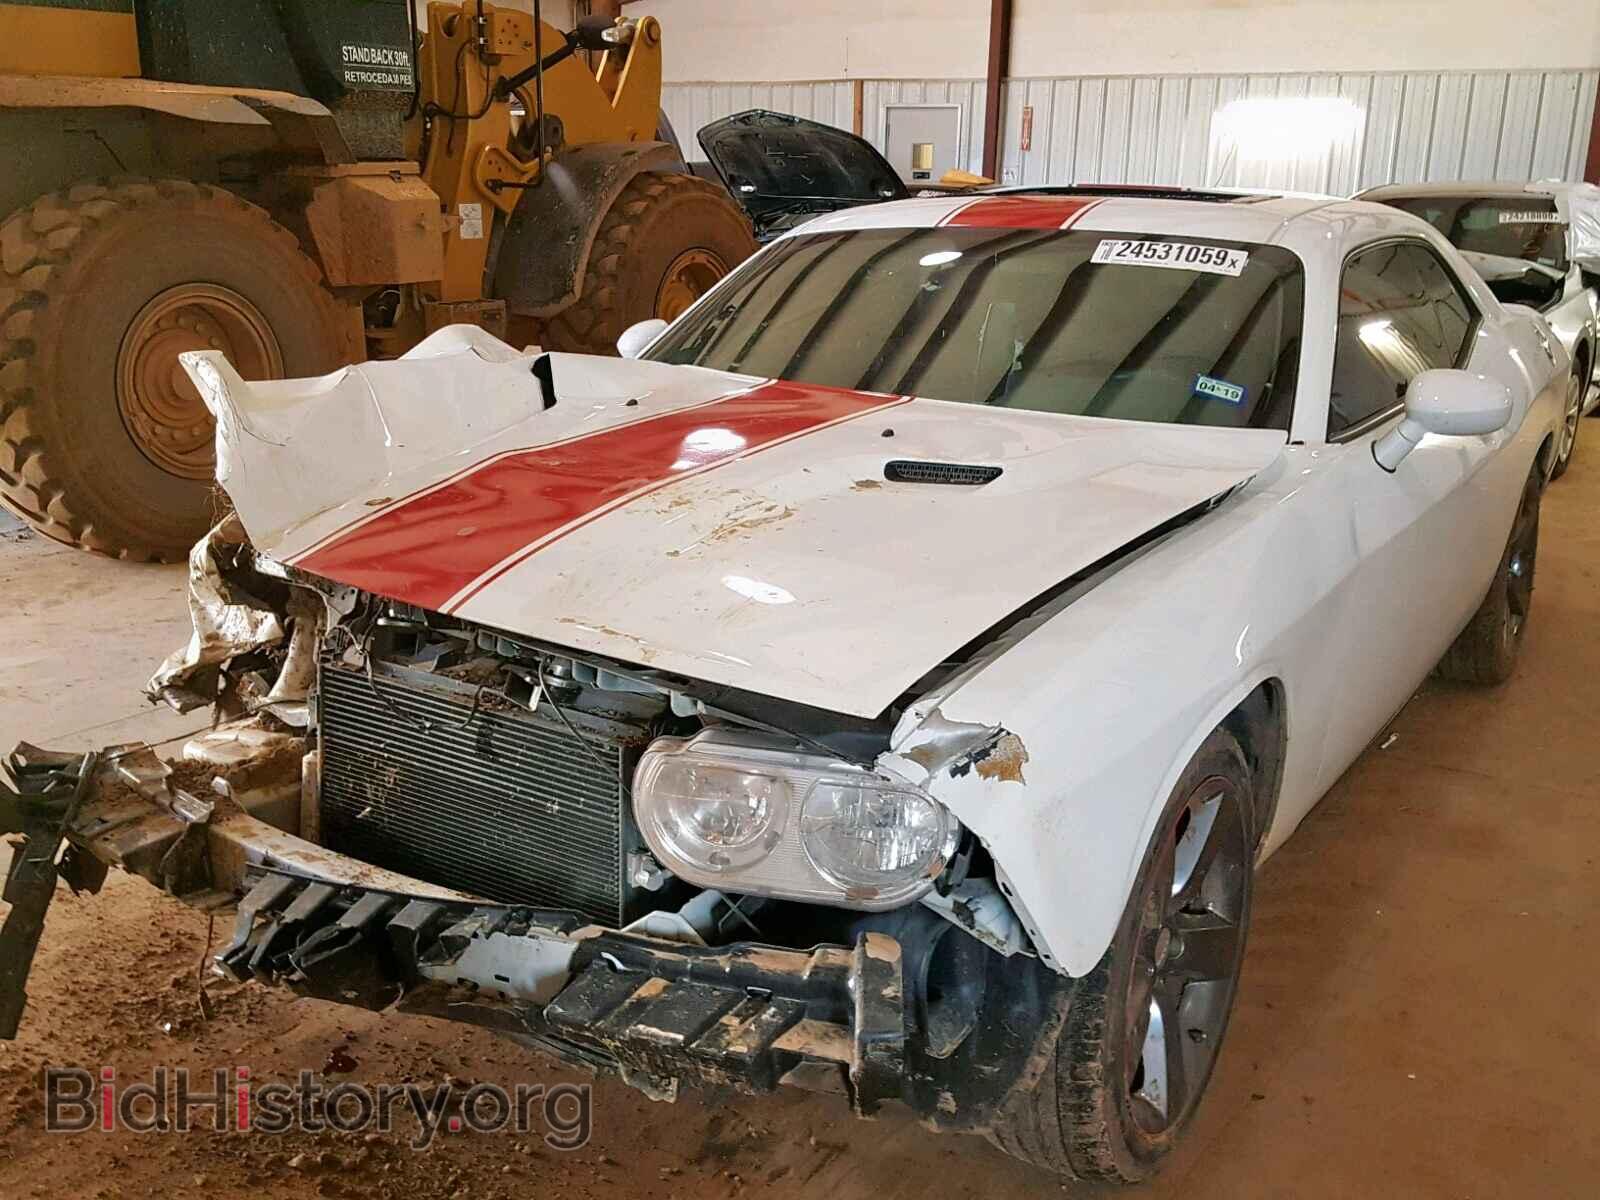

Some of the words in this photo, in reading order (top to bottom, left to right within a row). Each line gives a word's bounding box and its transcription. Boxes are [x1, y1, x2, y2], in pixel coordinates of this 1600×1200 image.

[342, 46, 371, 63] STAND
[371, 48, 394, 65] BACK
[344, 71, 393, 84] RETROCEDA
